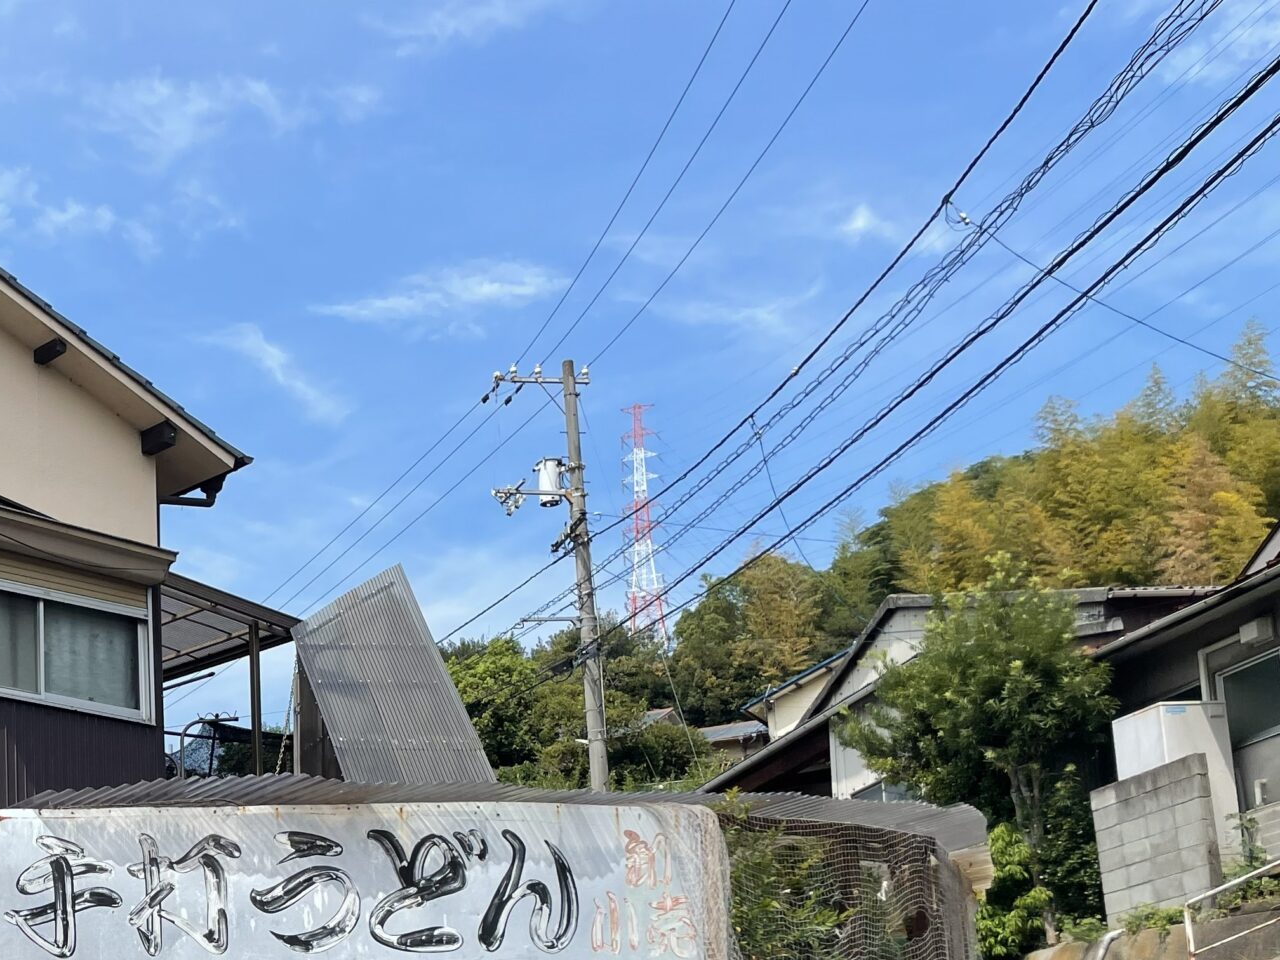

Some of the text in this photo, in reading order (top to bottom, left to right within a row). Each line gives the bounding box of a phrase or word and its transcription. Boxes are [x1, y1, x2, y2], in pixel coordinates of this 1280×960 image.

[3, 829, 579, 958] 手打うどん
